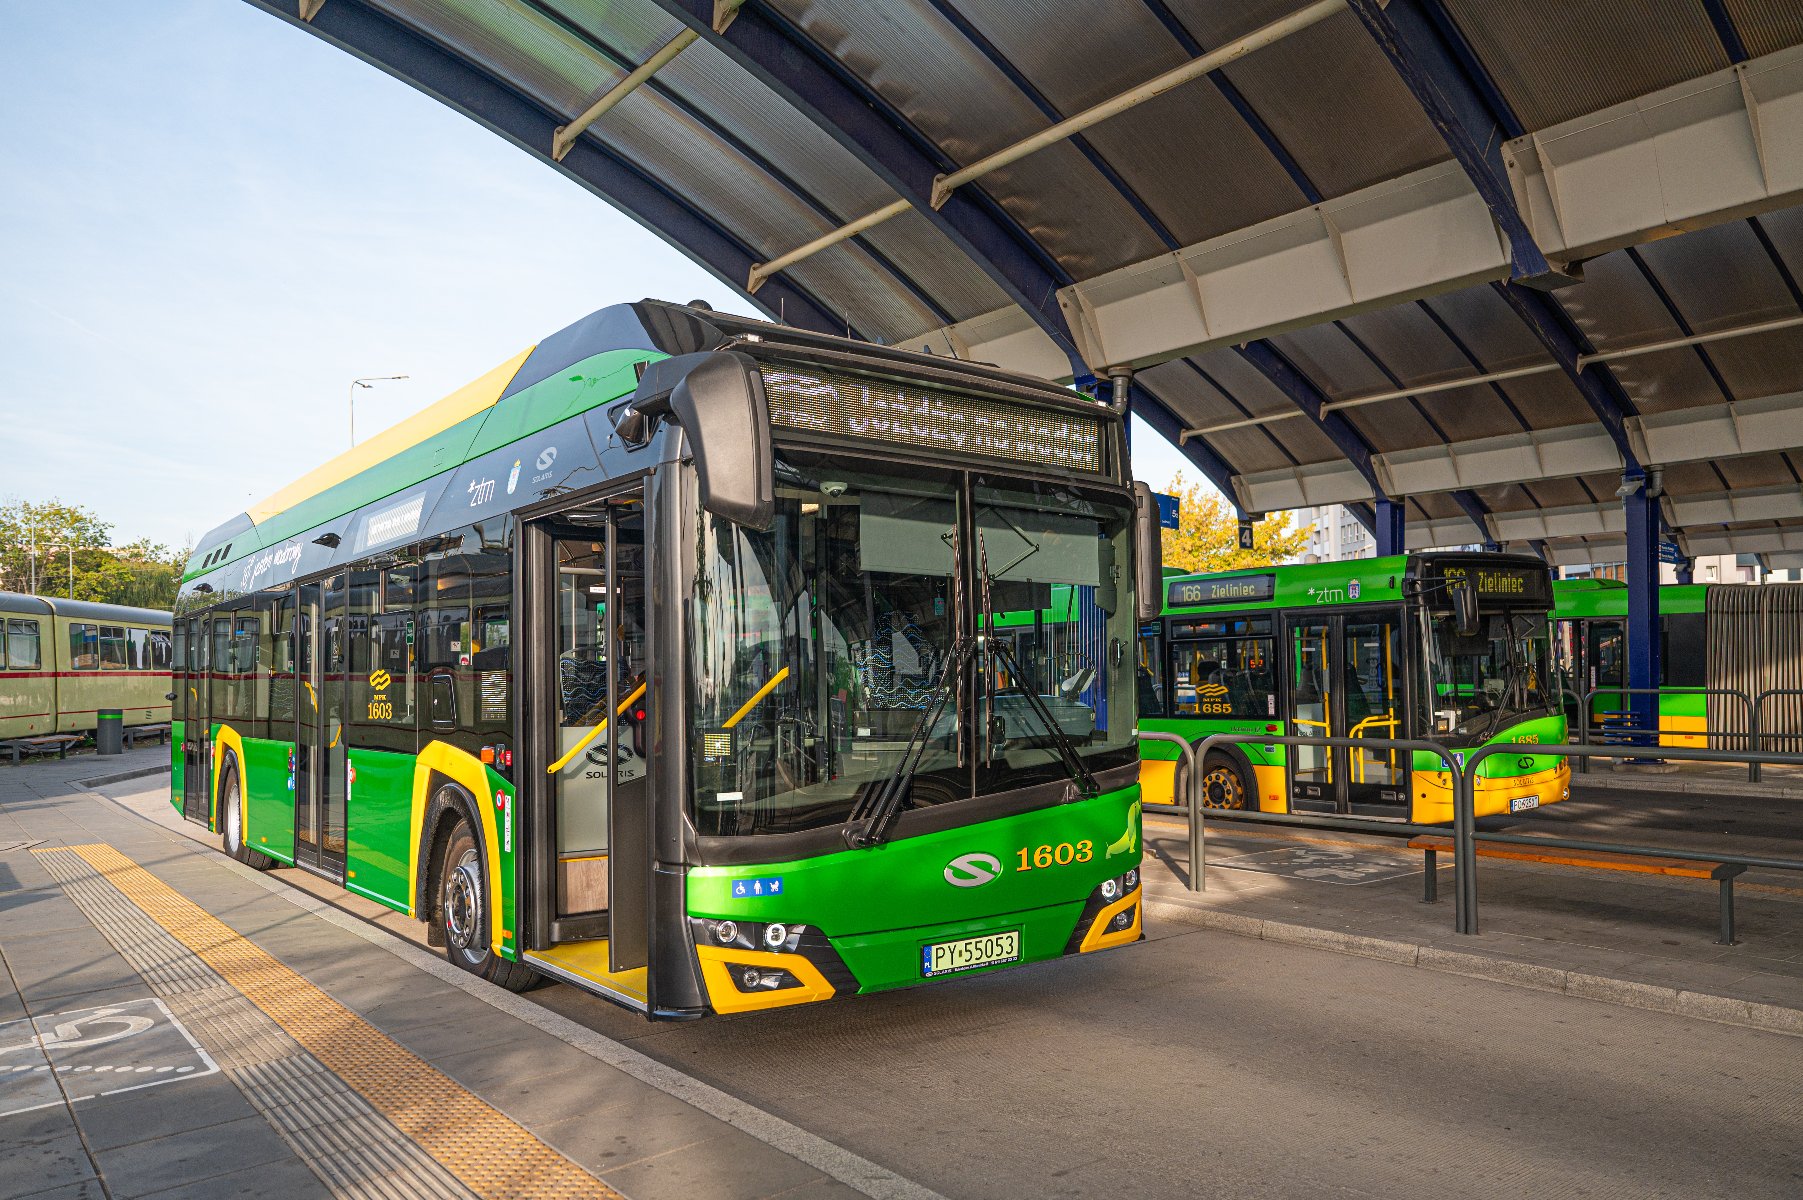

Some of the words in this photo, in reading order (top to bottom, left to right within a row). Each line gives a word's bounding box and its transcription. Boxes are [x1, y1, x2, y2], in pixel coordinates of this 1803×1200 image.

[1241, 529, 1252, 546] 4
[1478, 572, 1524, 593] Zieliniec
[1181, 585, 1200, 602] 166
[1211, 583, 1255, 598] Zieliniec
[367, 702, 393, 720] 1603
[1194, 703, 1232, 714] 1685
[1511, 734, 1539, 745] 1685
[585, 769, 635, 779] SOLRIS
[1016, 839, 1093, 872] 1603
[935, 944, 957, 969] PY
[964, 935, 1014, 962] 55053
